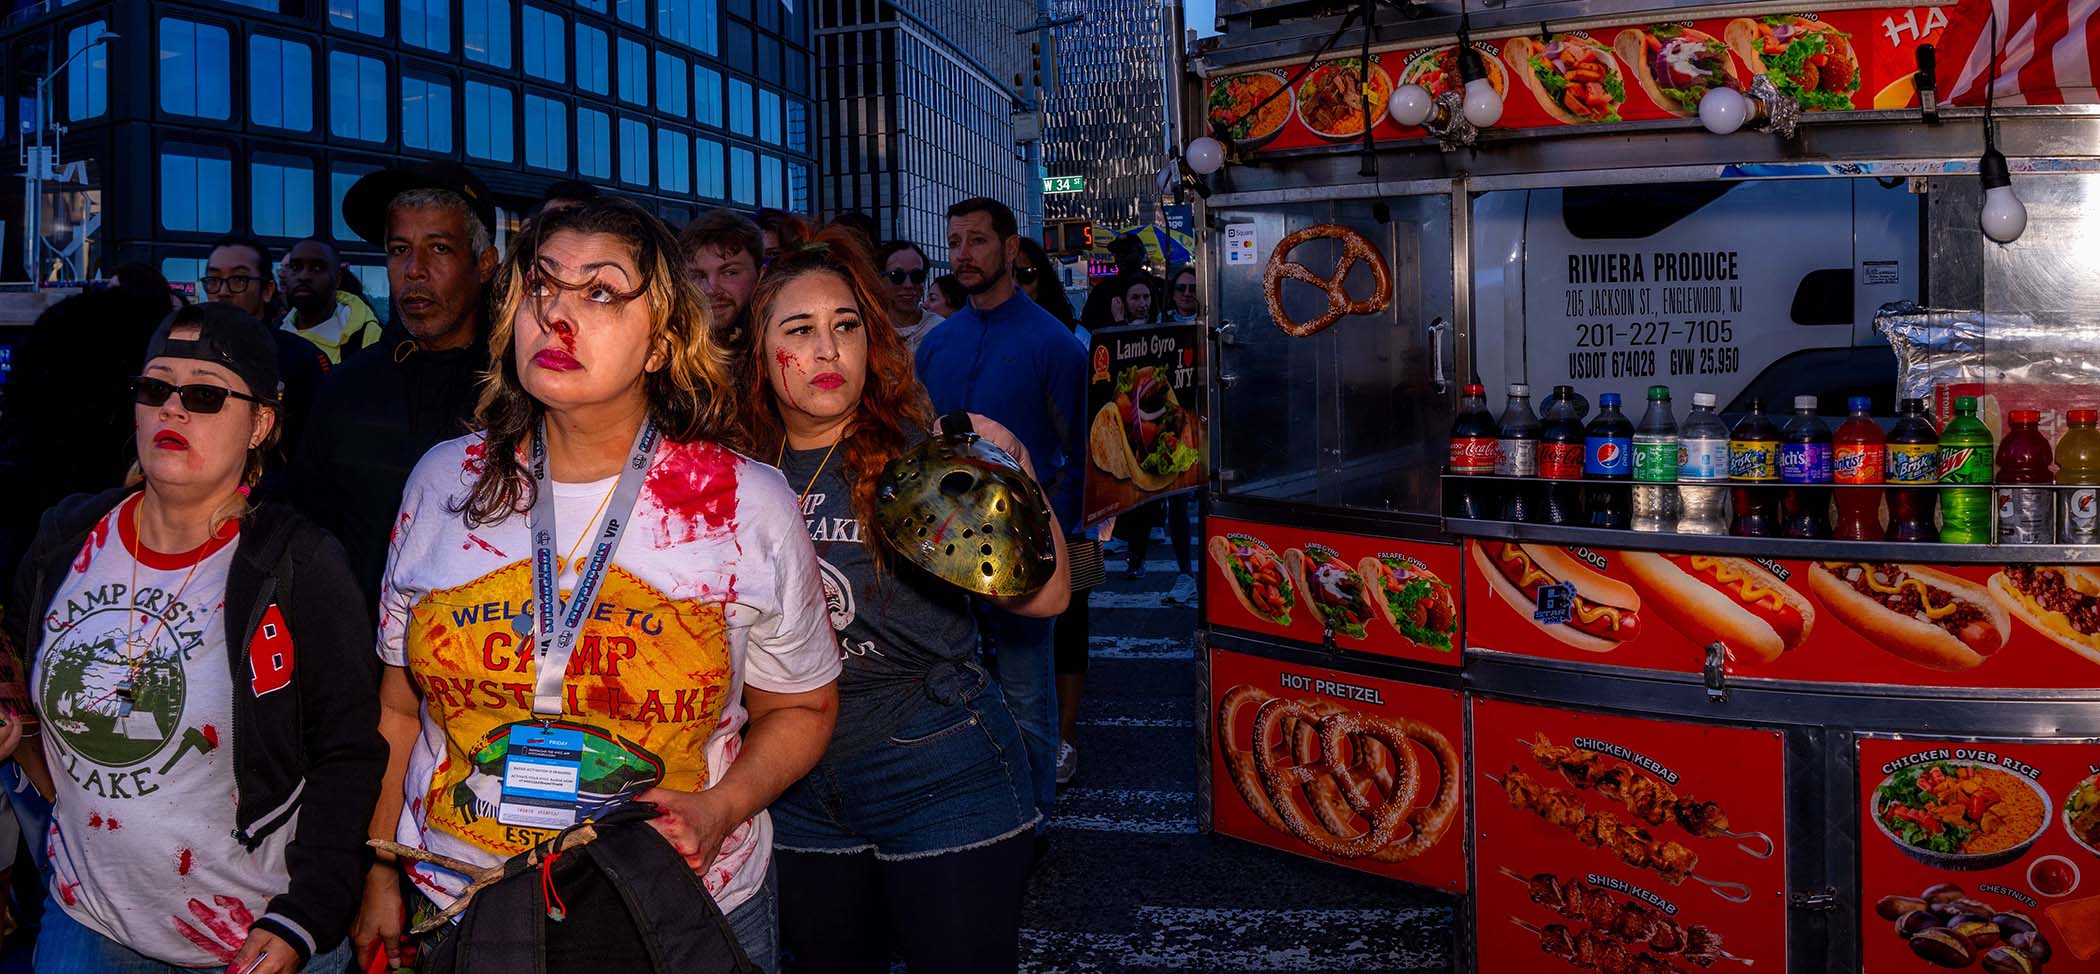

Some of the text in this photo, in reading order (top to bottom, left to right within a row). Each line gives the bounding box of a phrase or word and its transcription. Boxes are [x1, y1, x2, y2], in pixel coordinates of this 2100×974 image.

[1475, 40, 1500, 56] RICE
[1043, 180, 1053, 191] W
[1056, 180, 1071, 191] 34
[1083, 227, 1093, 245] 5
[1568, 251, 1739, 284] RIVIERA PRODUCE
[1565, 286, 1742, 318] 205 JACKSON ST., ENGLEWOOD, NJ
[1576, 319, 1733, 347] 201-227-7105
[1116, 334, 1176, 361] Lamb Gyro
[1176, 348, 1184, 369] I
[1569, 352, 1607, 379] USDOT
[1612, 350, 1655, 378] 674028
[1670, 349, 1695, 376] GVW
[1174, 367, 1194, 389] NY
[1781, 452, 1806, 466] lch's
[1900, 455, 1928, 476] Brisk
[604, 519, 621, 539] VIP
[1226, 532, 1270, 550] CHICKEN GYRO
[1304, 542, 1340, 558] LAMB GYRO
[1377, 552, 1427, 571] FALAFEL GYRO
[1578, 547, 1606, 569] DOG
[47, 584, 127, 633] CAMP
[1281, 673, 1384, 705] HOT PRETZEL
[608, 684, 720, 724] LAKE
[1574, 737, 1678, 784] CHICKEN KEBAB
[1881, 749, 2041, 780] CHICKEN OVER RICE
[67, 755, 160, 799] LAKE
[1587, 873, 1677, 915] SHISH KEBAB
[1979, 883, 2038, 908] CHESTNUTS
